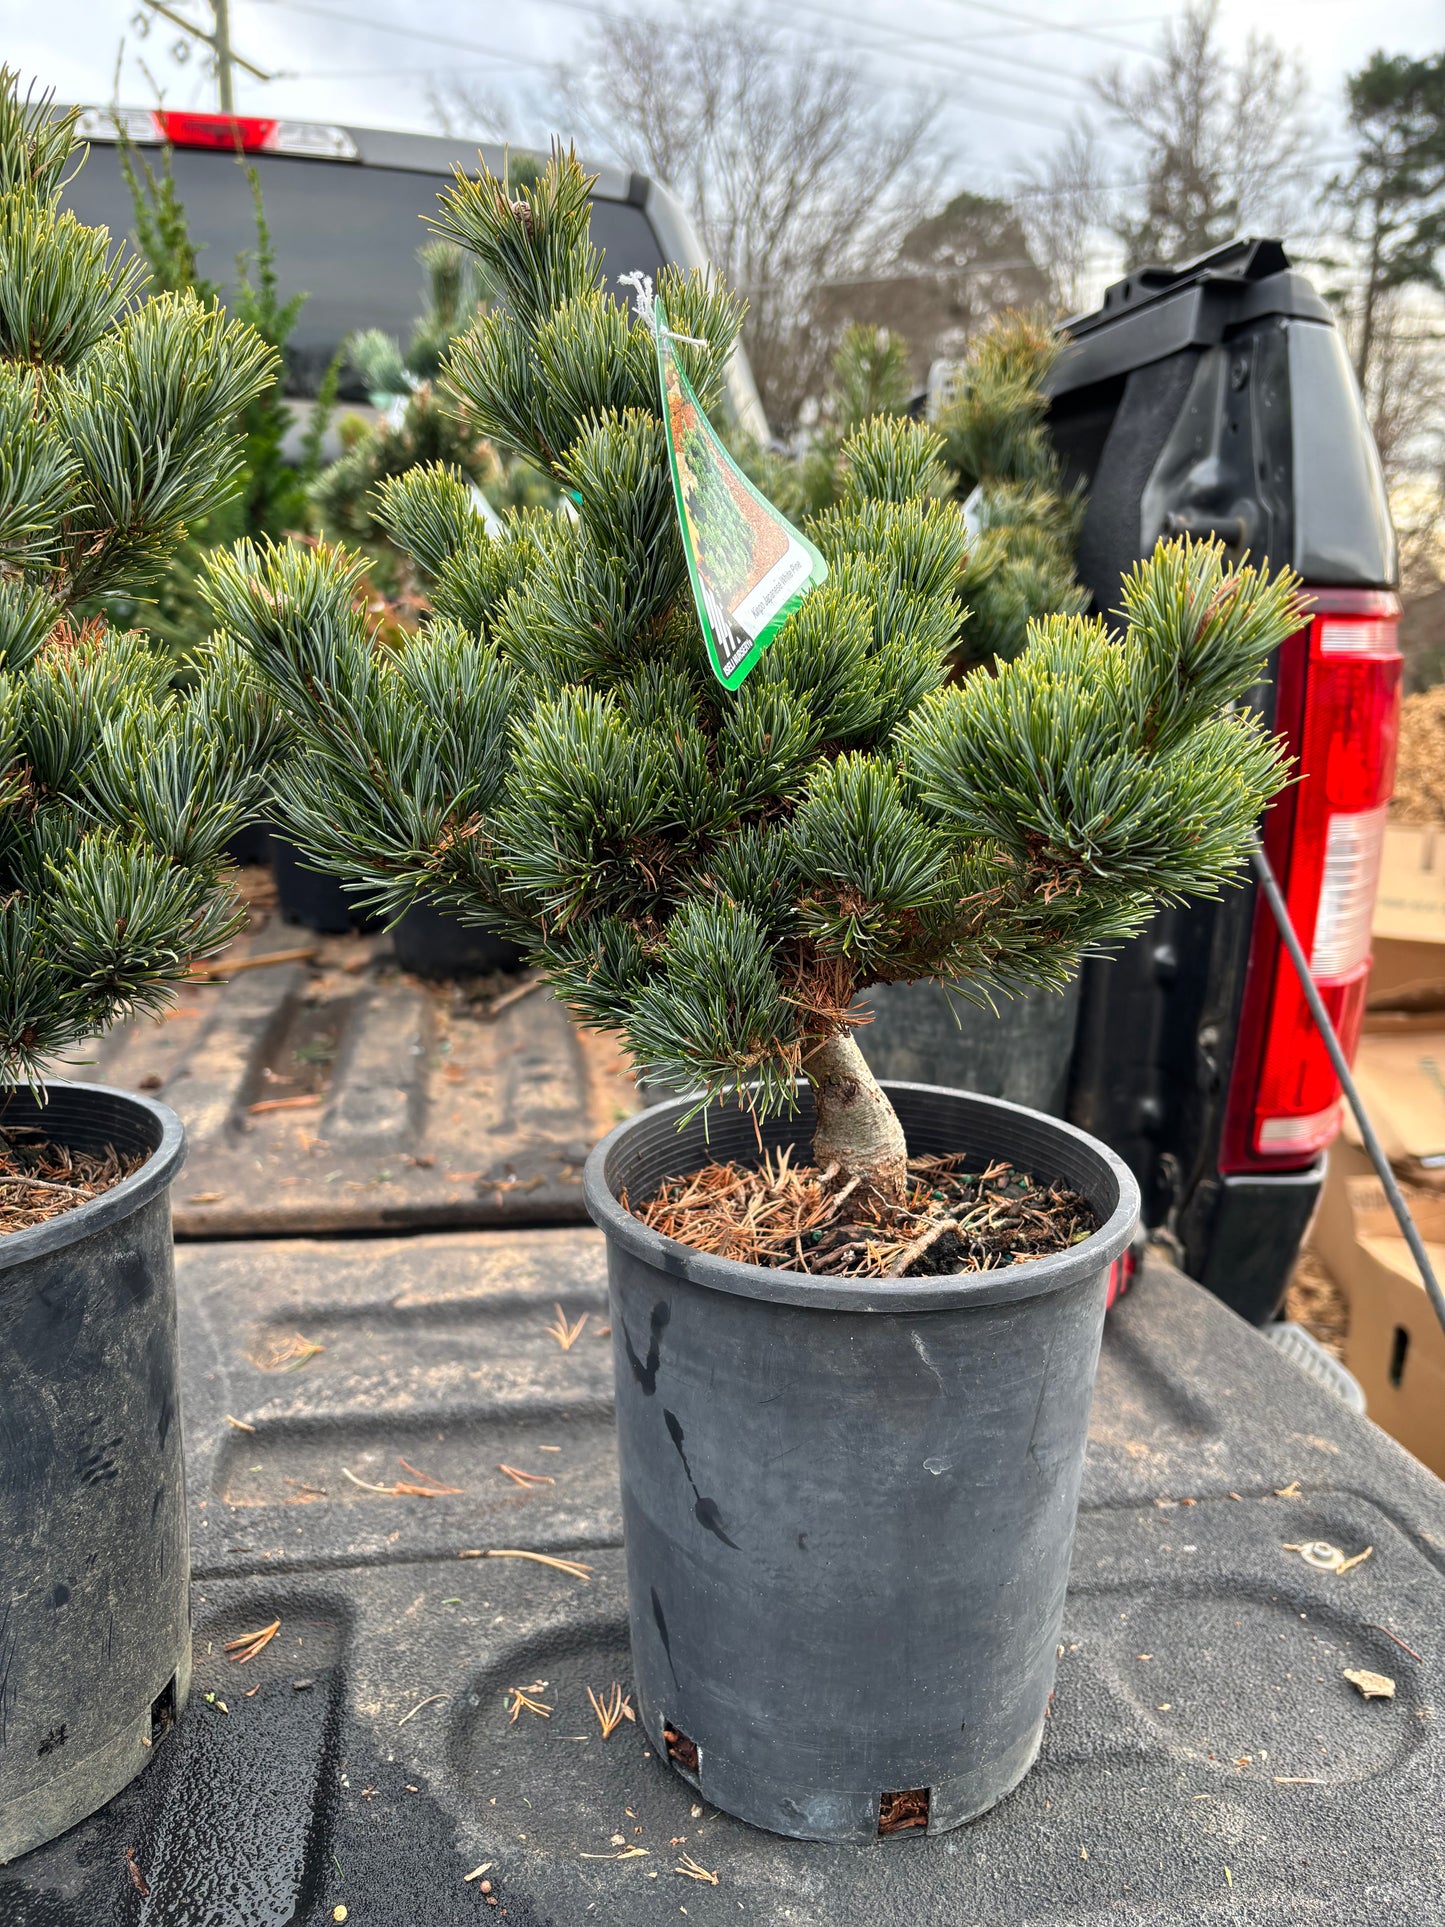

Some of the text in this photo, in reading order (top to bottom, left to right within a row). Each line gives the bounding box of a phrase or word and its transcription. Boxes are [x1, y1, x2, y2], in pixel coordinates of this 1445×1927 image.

[762, 581, 784, 606] Japanese
[779, 570, 794, 585] White
[789, 560, 802, 574] Pine
